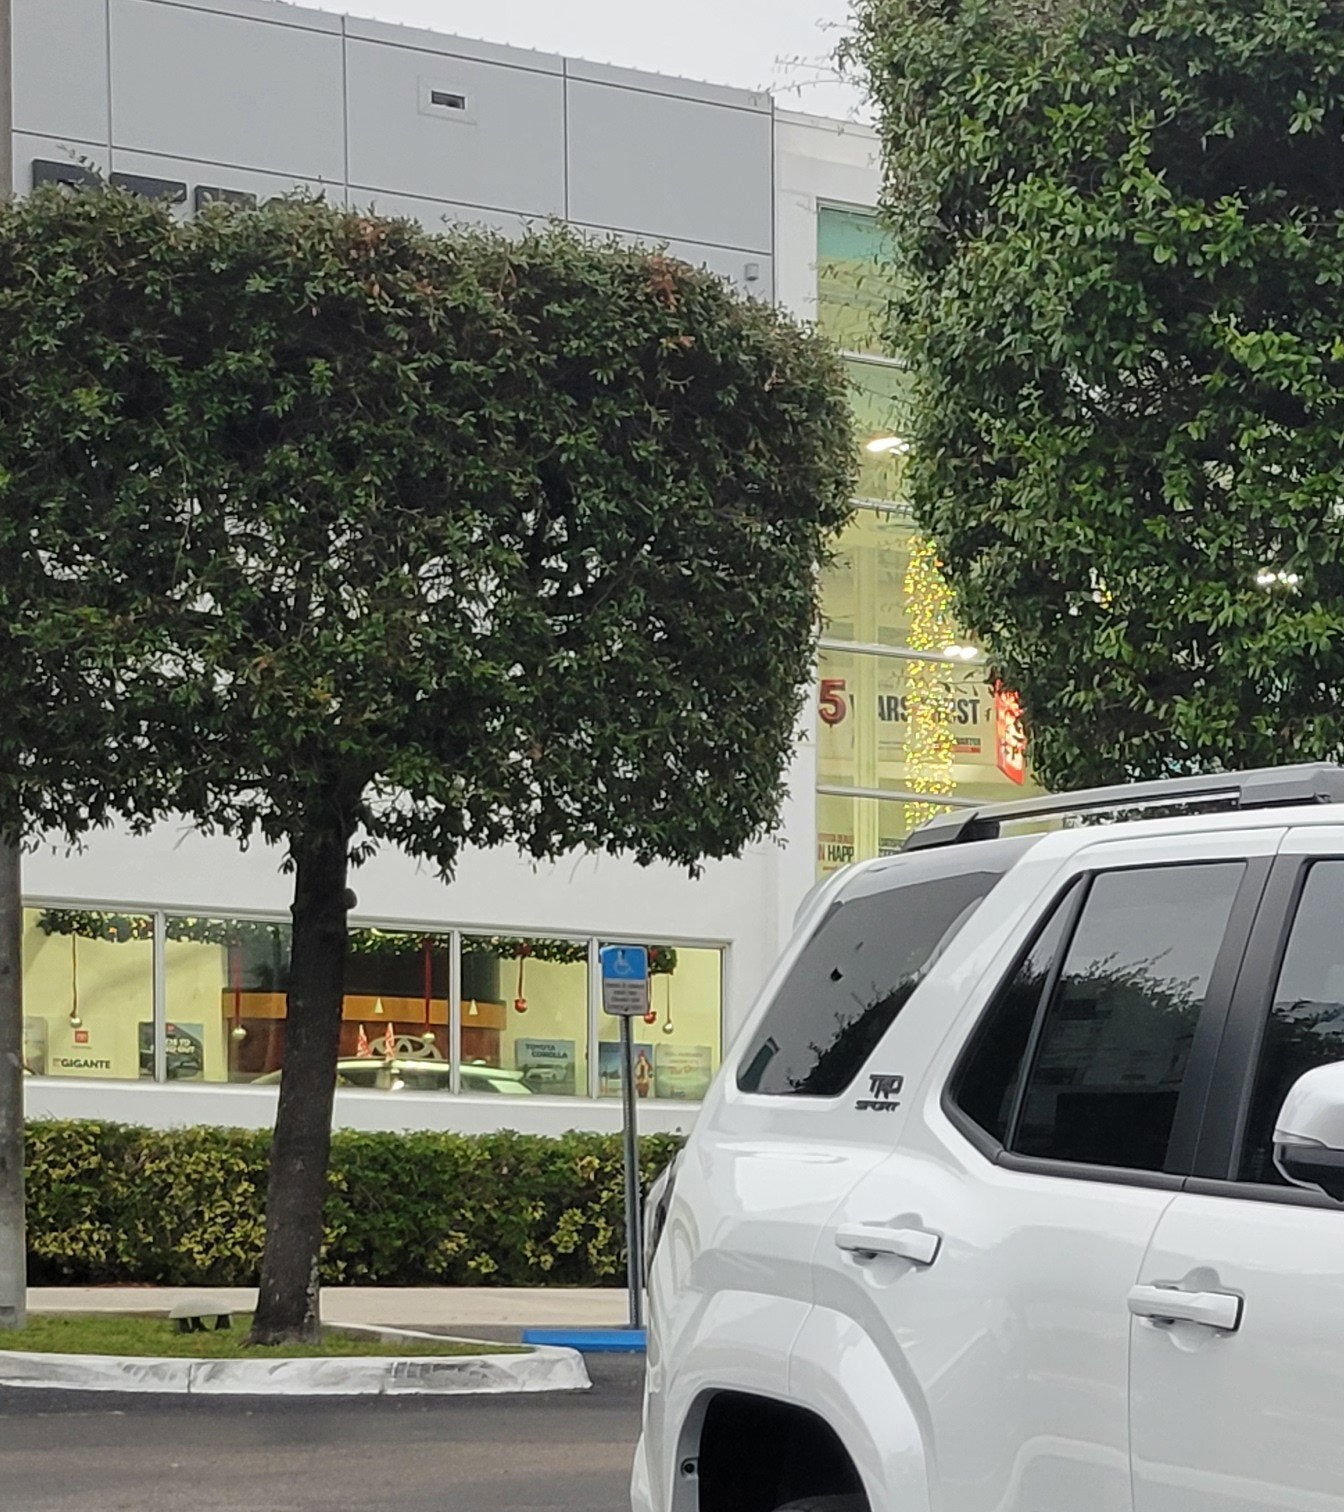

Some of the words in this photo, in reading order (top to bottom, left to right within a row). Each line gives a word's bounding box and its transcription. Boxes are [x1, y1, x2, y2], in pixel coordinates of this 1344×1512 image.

[60, 1058, 111, 1069] GIGANTE
[869, 1074, 904, 1100] TRD
[854, 1100, 901, 1112] SPORT
